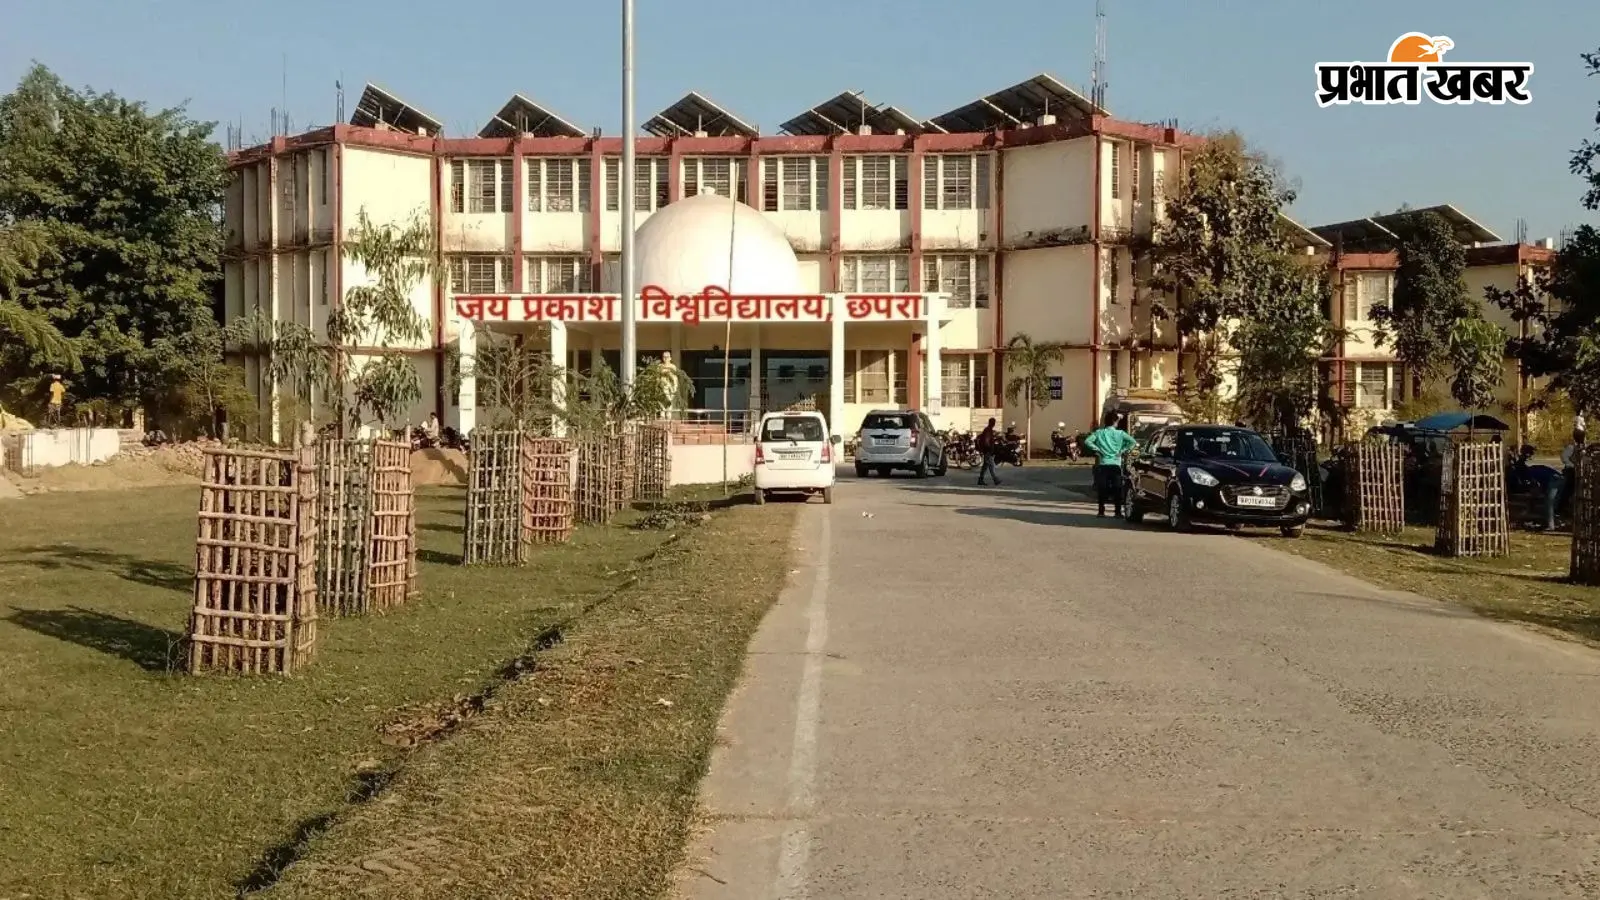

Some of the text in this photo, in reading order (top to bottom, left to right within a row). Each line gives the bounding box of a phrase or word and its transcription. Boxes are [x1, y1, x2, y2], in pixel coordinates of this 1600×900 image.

[455, 285, 923, 326] जय प्रकाश विश्वविद्यालय, छपरा
